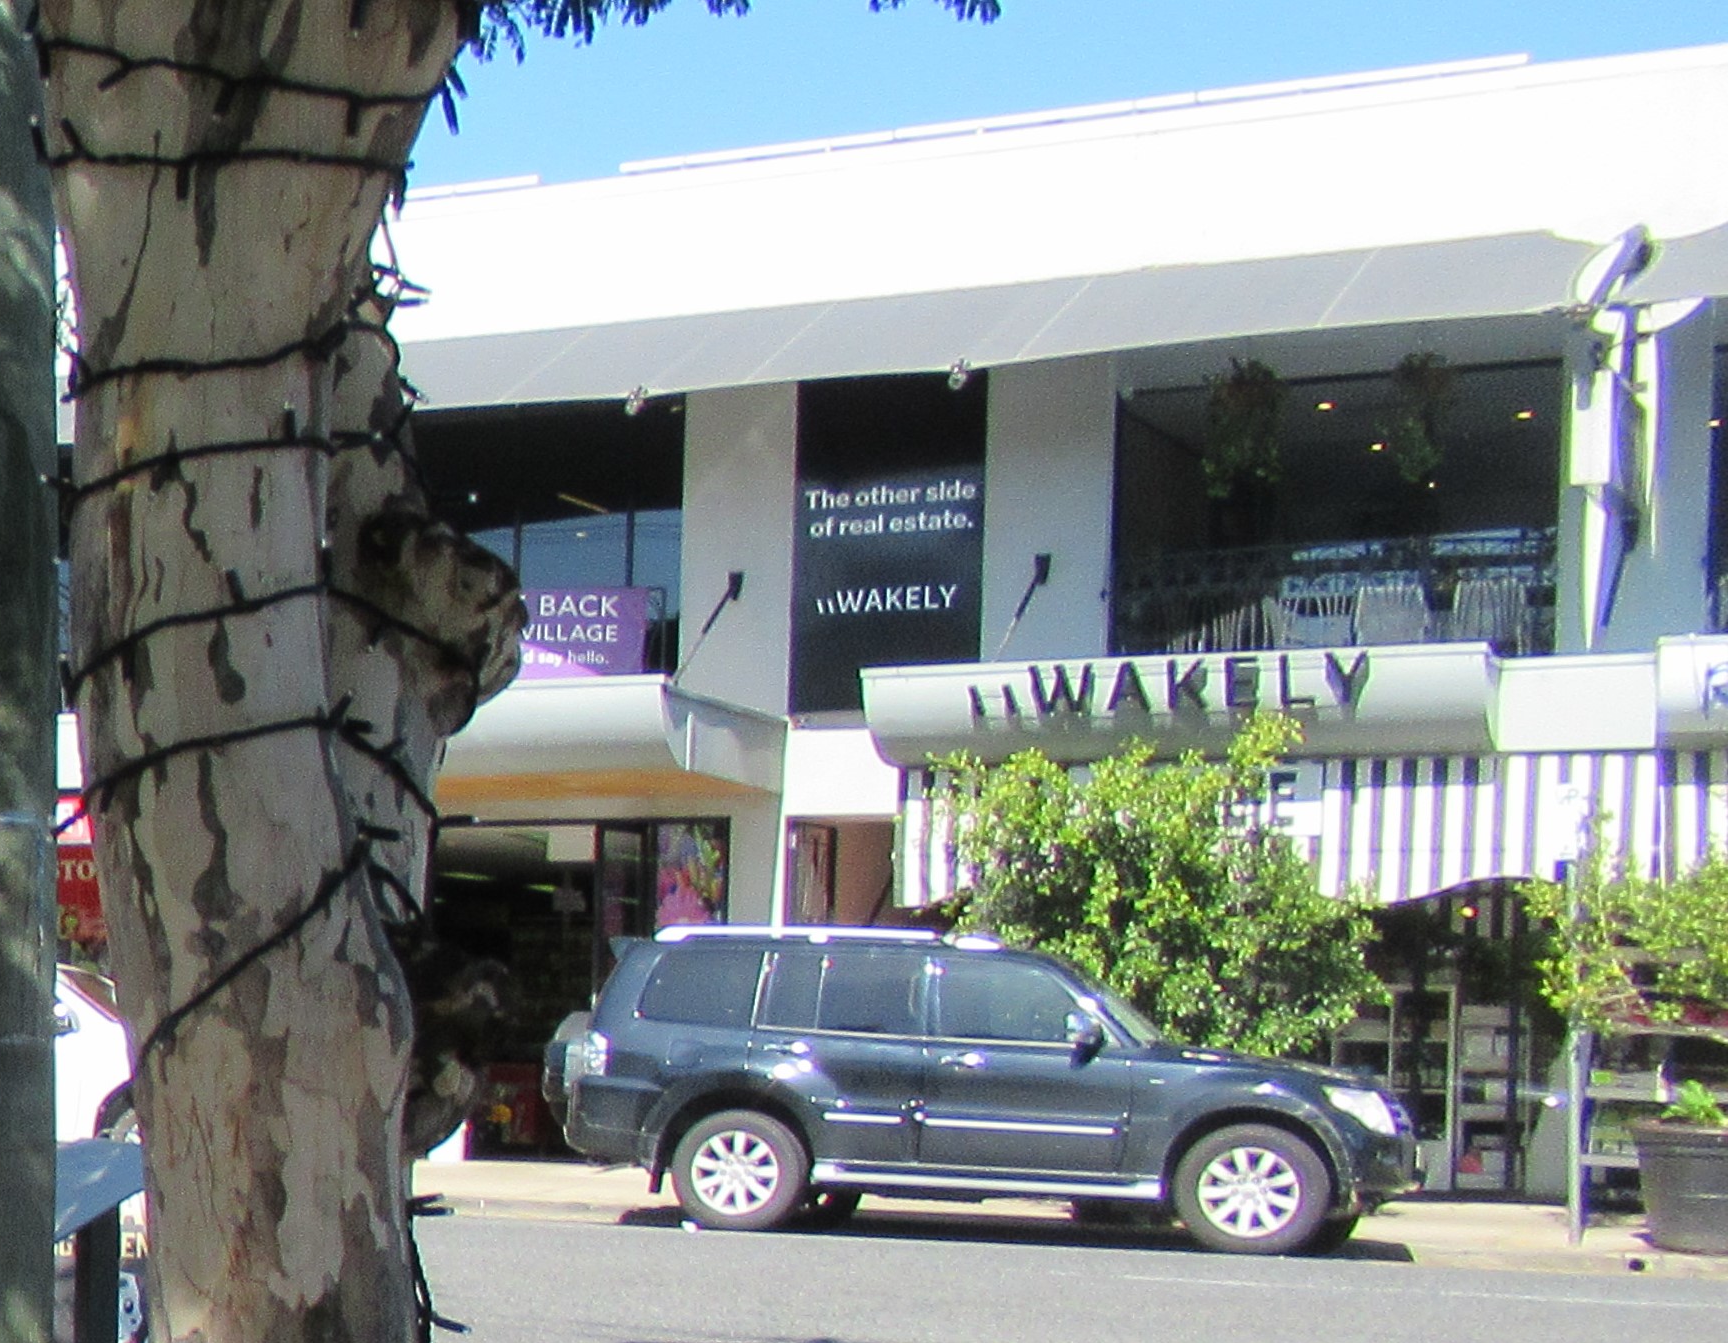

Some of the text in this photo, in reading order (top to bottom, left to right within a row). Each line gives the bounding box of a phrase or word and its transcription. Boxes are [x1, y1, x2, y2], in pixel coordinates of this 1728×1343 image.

[805, 479, 976, 510] The other side
[810, 509, 974, 539] of real estate.
[539, 594, 620, 617] BACK
[836, 583, 957, 614] WAKELY
[521, 623, 618, 642] VILLAGE
[538, 651, 563, 667] say
[567, 649, 609, 664] hello.
[1028, 650, 1372, 716] WAKELY
